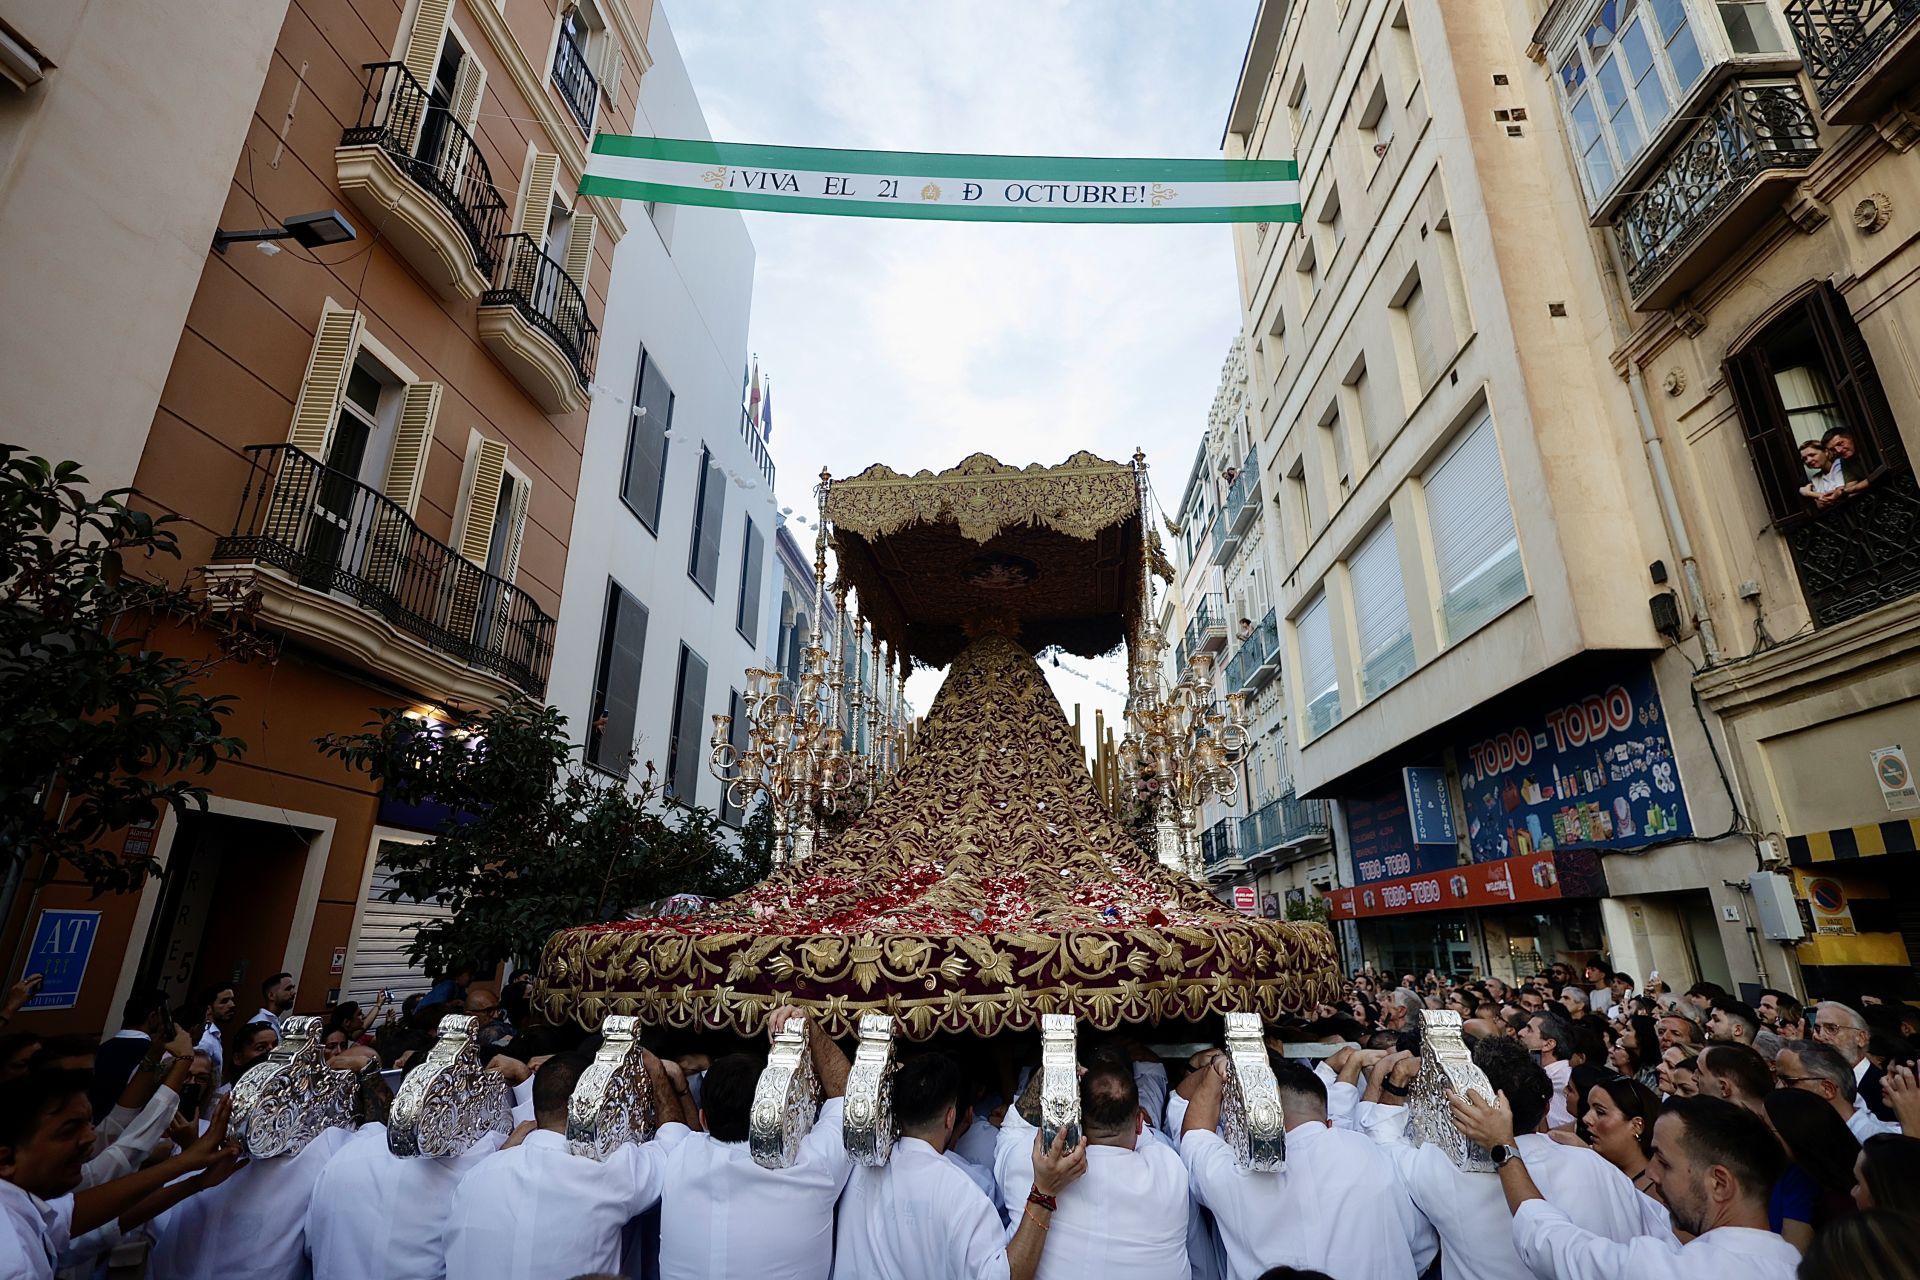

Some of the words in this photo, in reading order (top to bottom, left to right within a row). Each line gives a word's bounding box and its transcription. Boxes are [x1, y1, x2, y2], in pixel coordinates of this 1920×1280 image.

[729, 170, 801, 192] ¡VIVA
[822, 176, 856, 196] EL
[876, 179, 900, 198] 21
[1004, 183, 1146, 203] OCTUBRE!
[1436, 778, 1452, 838] SOUVENIRS
[39, 918, 91, 954] AT
[177, 952, 194, 983] 5
